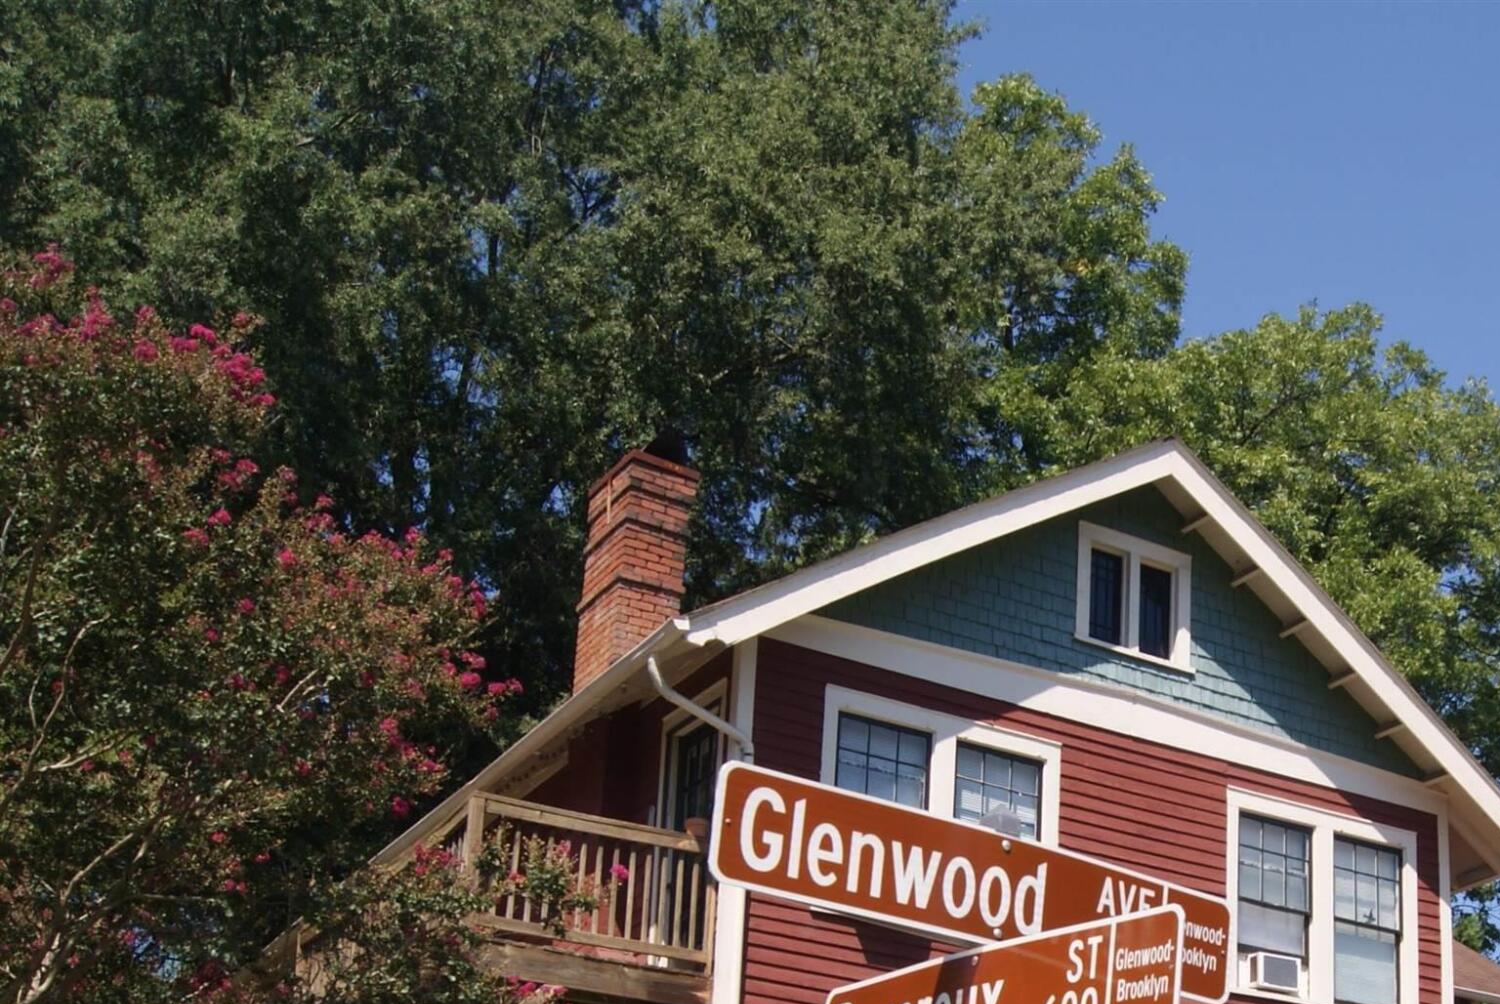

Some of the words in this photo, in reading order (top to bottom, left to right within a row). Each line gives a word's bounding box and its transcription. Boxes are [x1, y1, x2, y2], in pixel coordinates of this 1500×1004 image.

[739, 786, 1049, 936] Glenwood
[1096, 876, 1156, 917] AVE
[1184, 921, 1226, 946] nwood-
[1066, 934, 1104, 983] ST
[1115, 938, 1175, 971] Glenwood-
[1116, 974, 1169, 1002] Brooklyn
